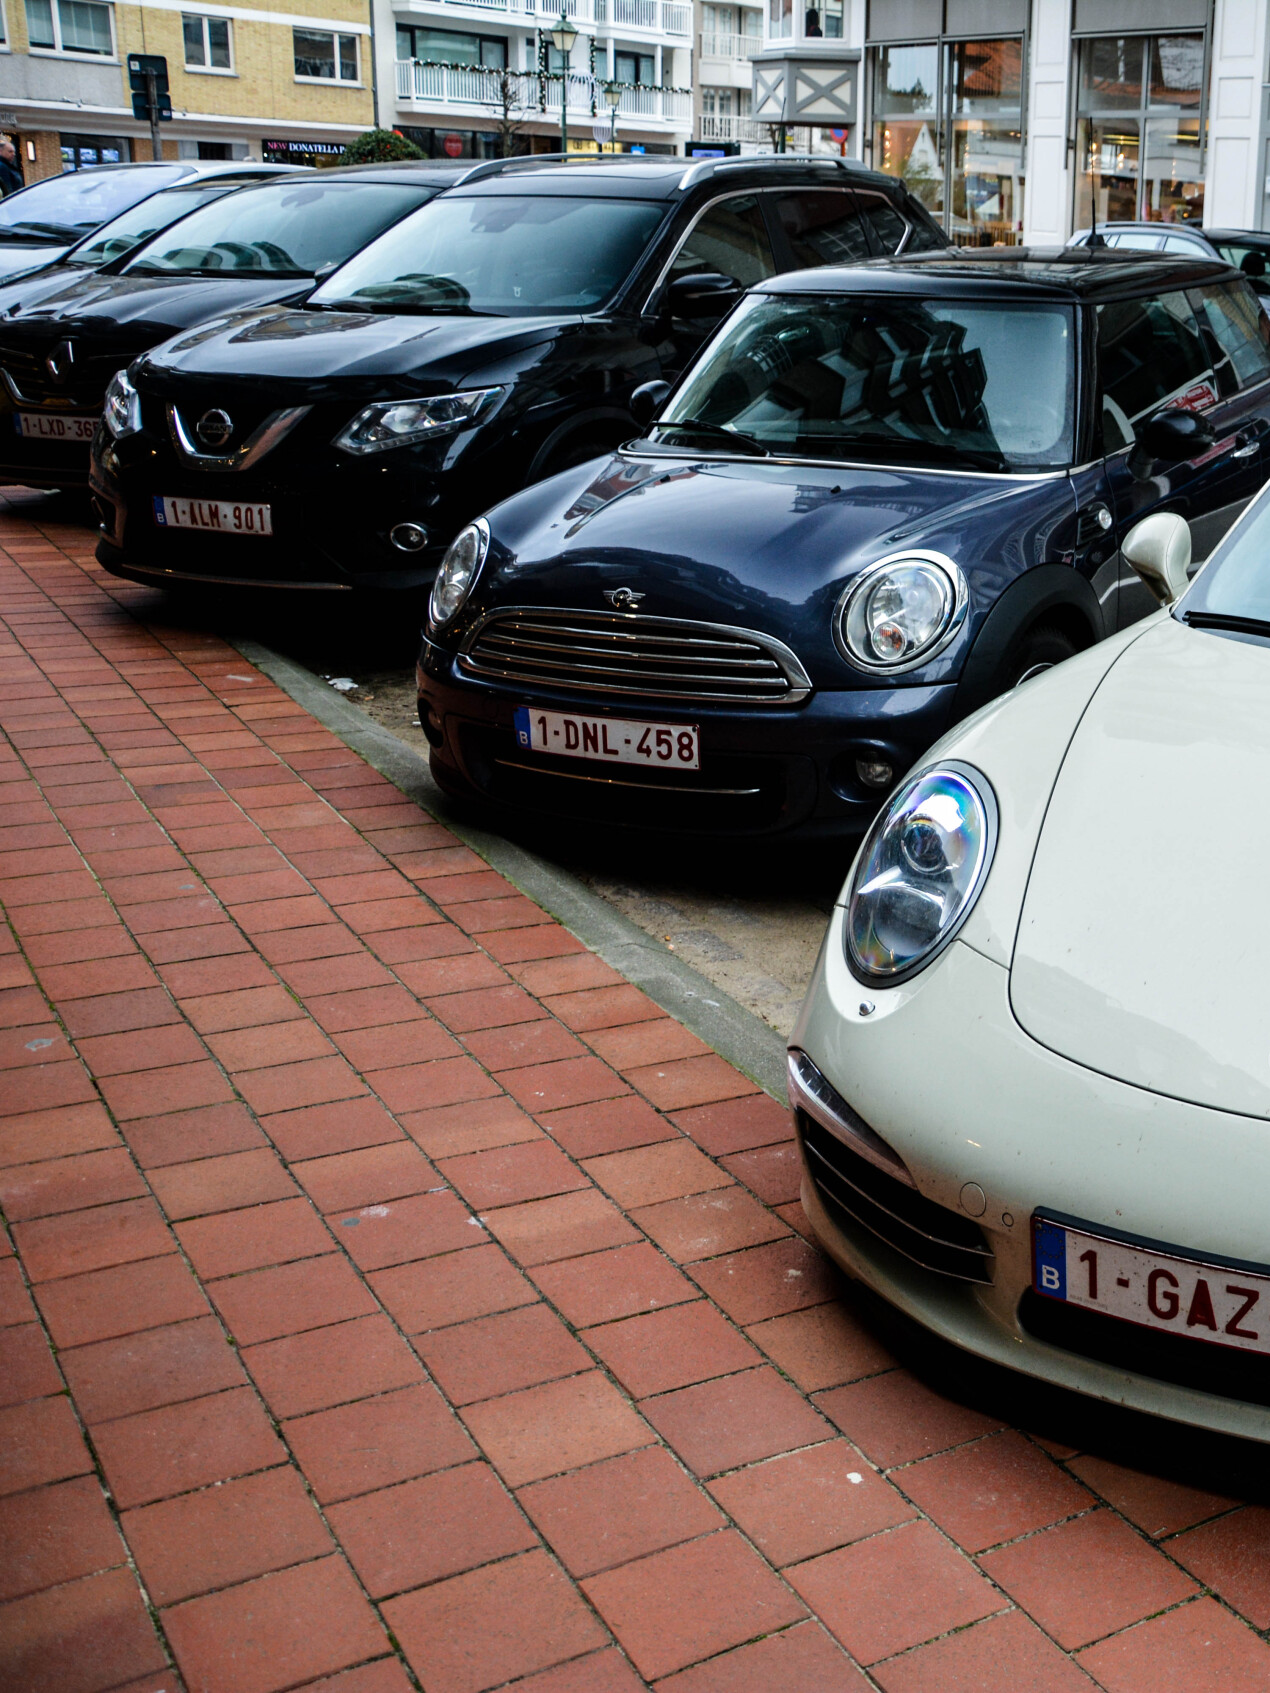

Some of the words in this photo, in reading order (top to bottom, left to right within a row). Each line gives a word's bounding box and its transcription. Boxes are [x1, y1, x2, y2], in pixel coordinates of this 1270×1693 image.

[267, 141, 287, 150] NEW
[289, 142, 338, 154] DONATELLA
[519, 730, 529, 745] B
[537, 715, 694, 762] 1-DNL-458
[1041, 1264, 1060, 1291] B
